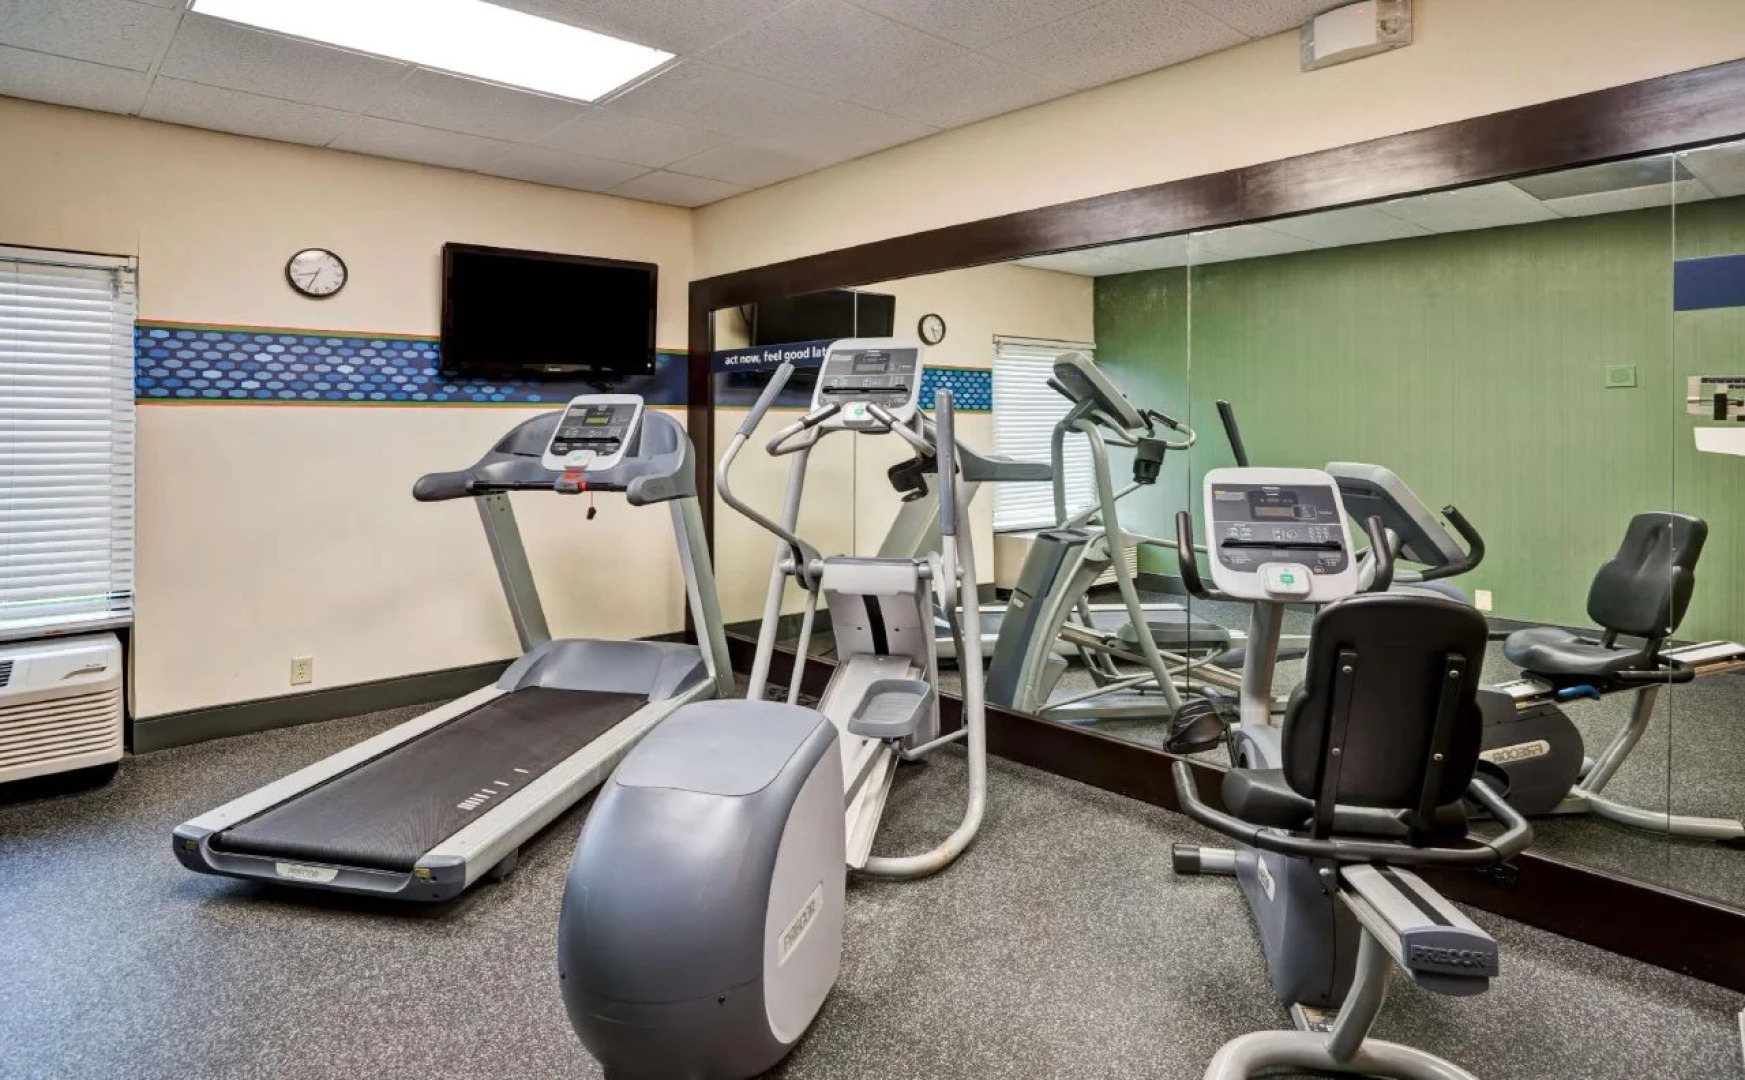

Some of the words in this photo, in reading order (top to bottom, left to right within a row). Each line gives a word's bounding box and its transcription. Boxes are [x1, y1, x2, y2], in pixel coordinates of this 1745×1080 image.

[725, 356, 738, 365] act
[740, 355, 762, 364] now,
[763, 349, 782, 361] feel
[784, 347, 810, 361] good
[812, 346, 827, 358] lat
[1411, 944, 1485, 968] PRECOR
